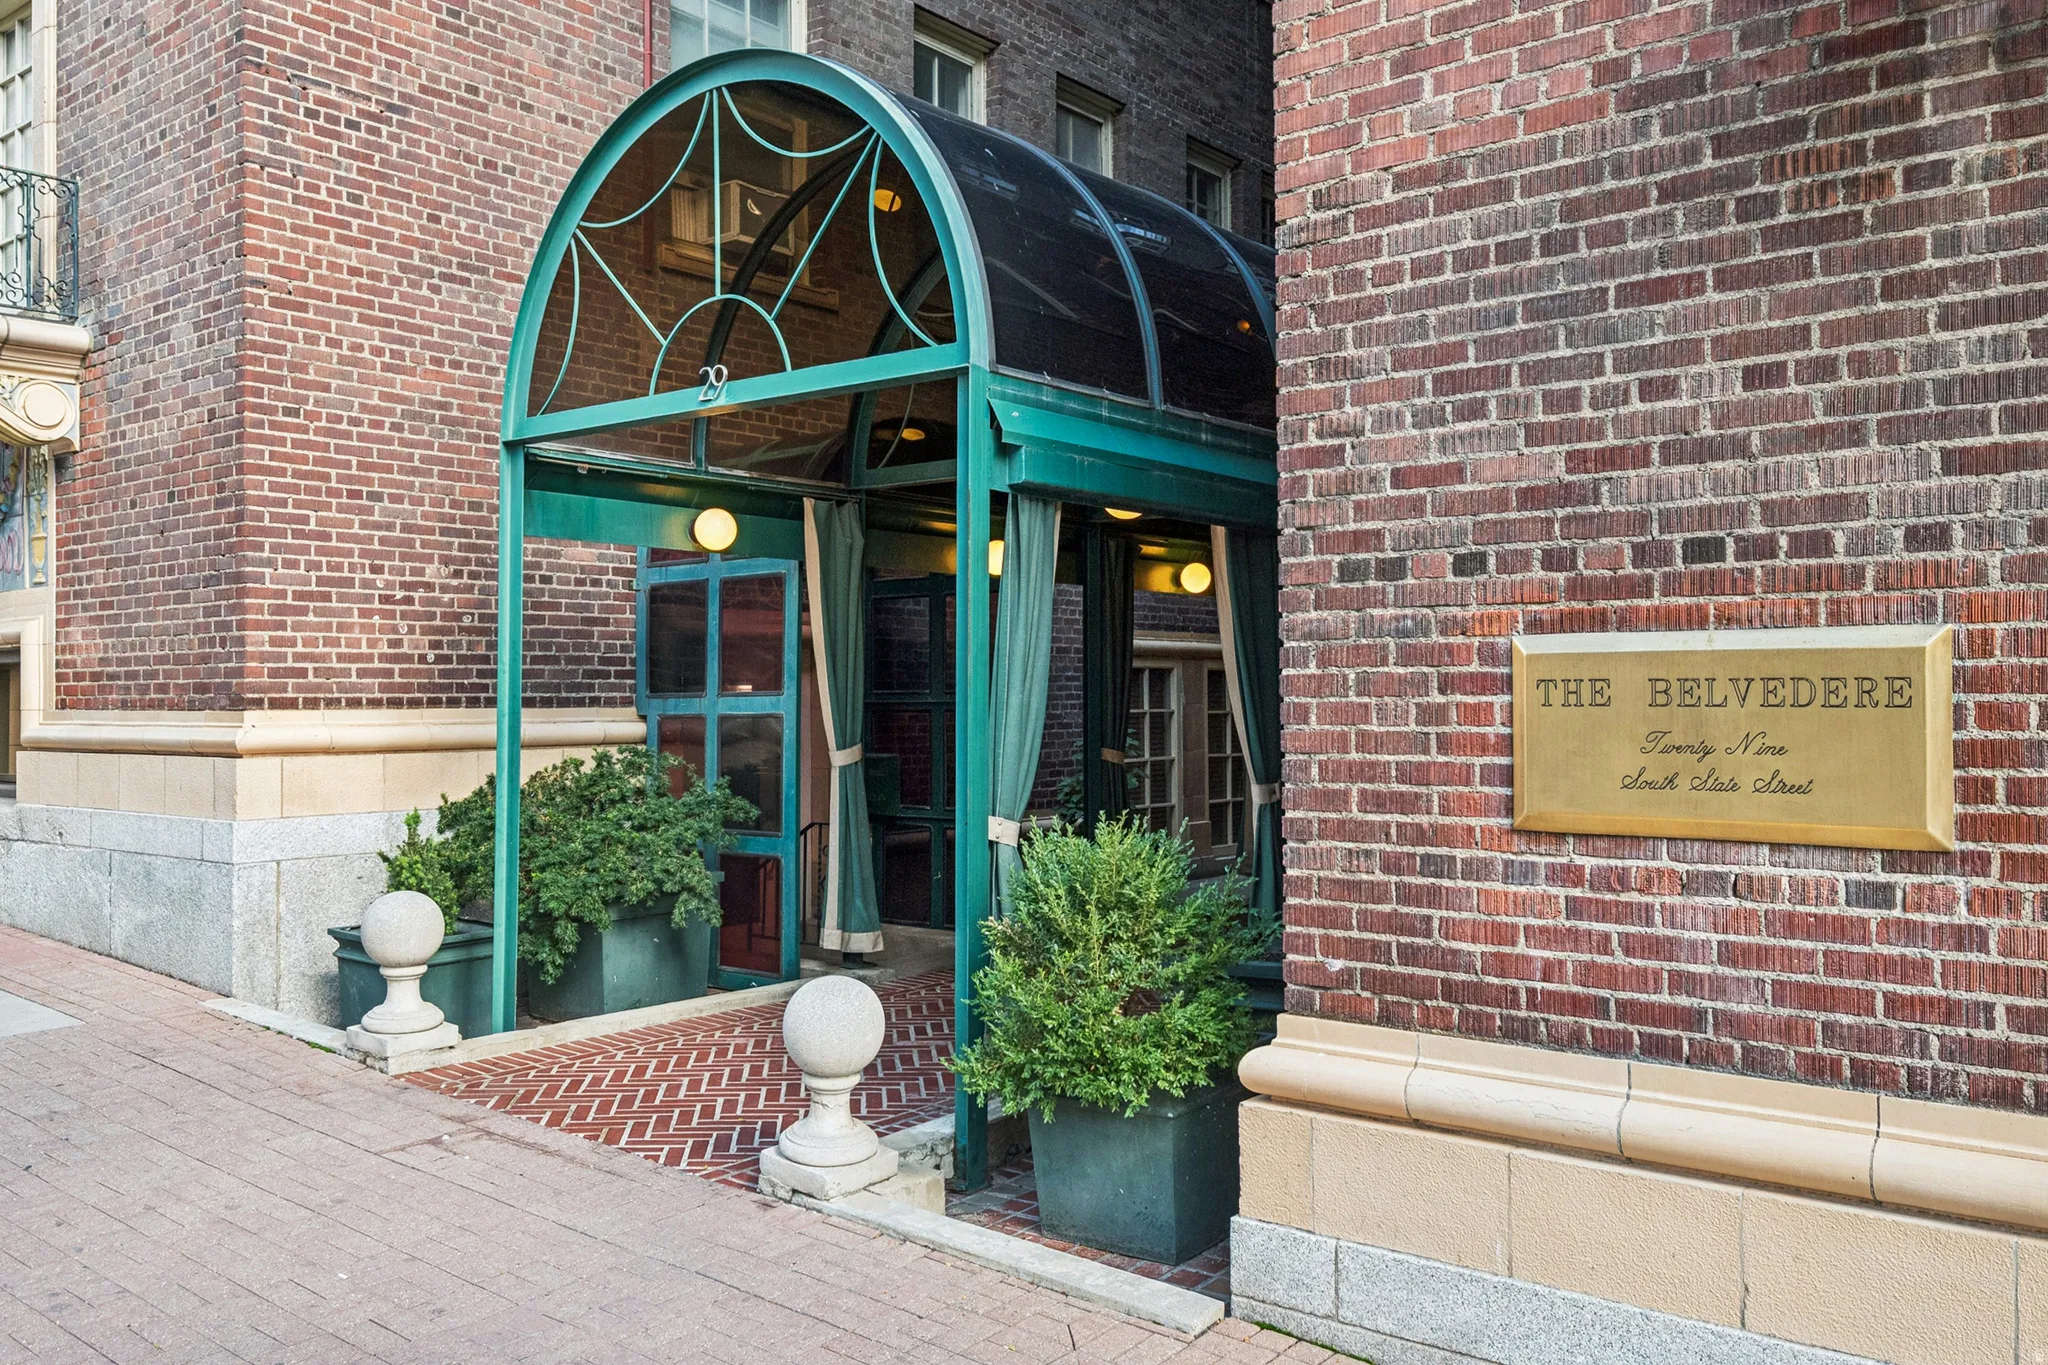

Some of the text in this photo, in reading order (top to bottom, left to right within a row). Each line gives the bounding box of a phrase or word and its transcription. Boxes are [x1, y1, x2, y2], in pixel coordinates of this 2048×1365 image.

[699, 365, 729, 401] 29
[1536, 676, 1914, 710] THE BELVEDERE
[1640, 730, 1788, 763] Twenty Nine
[1620, 766, 1815, 795] South State Street
